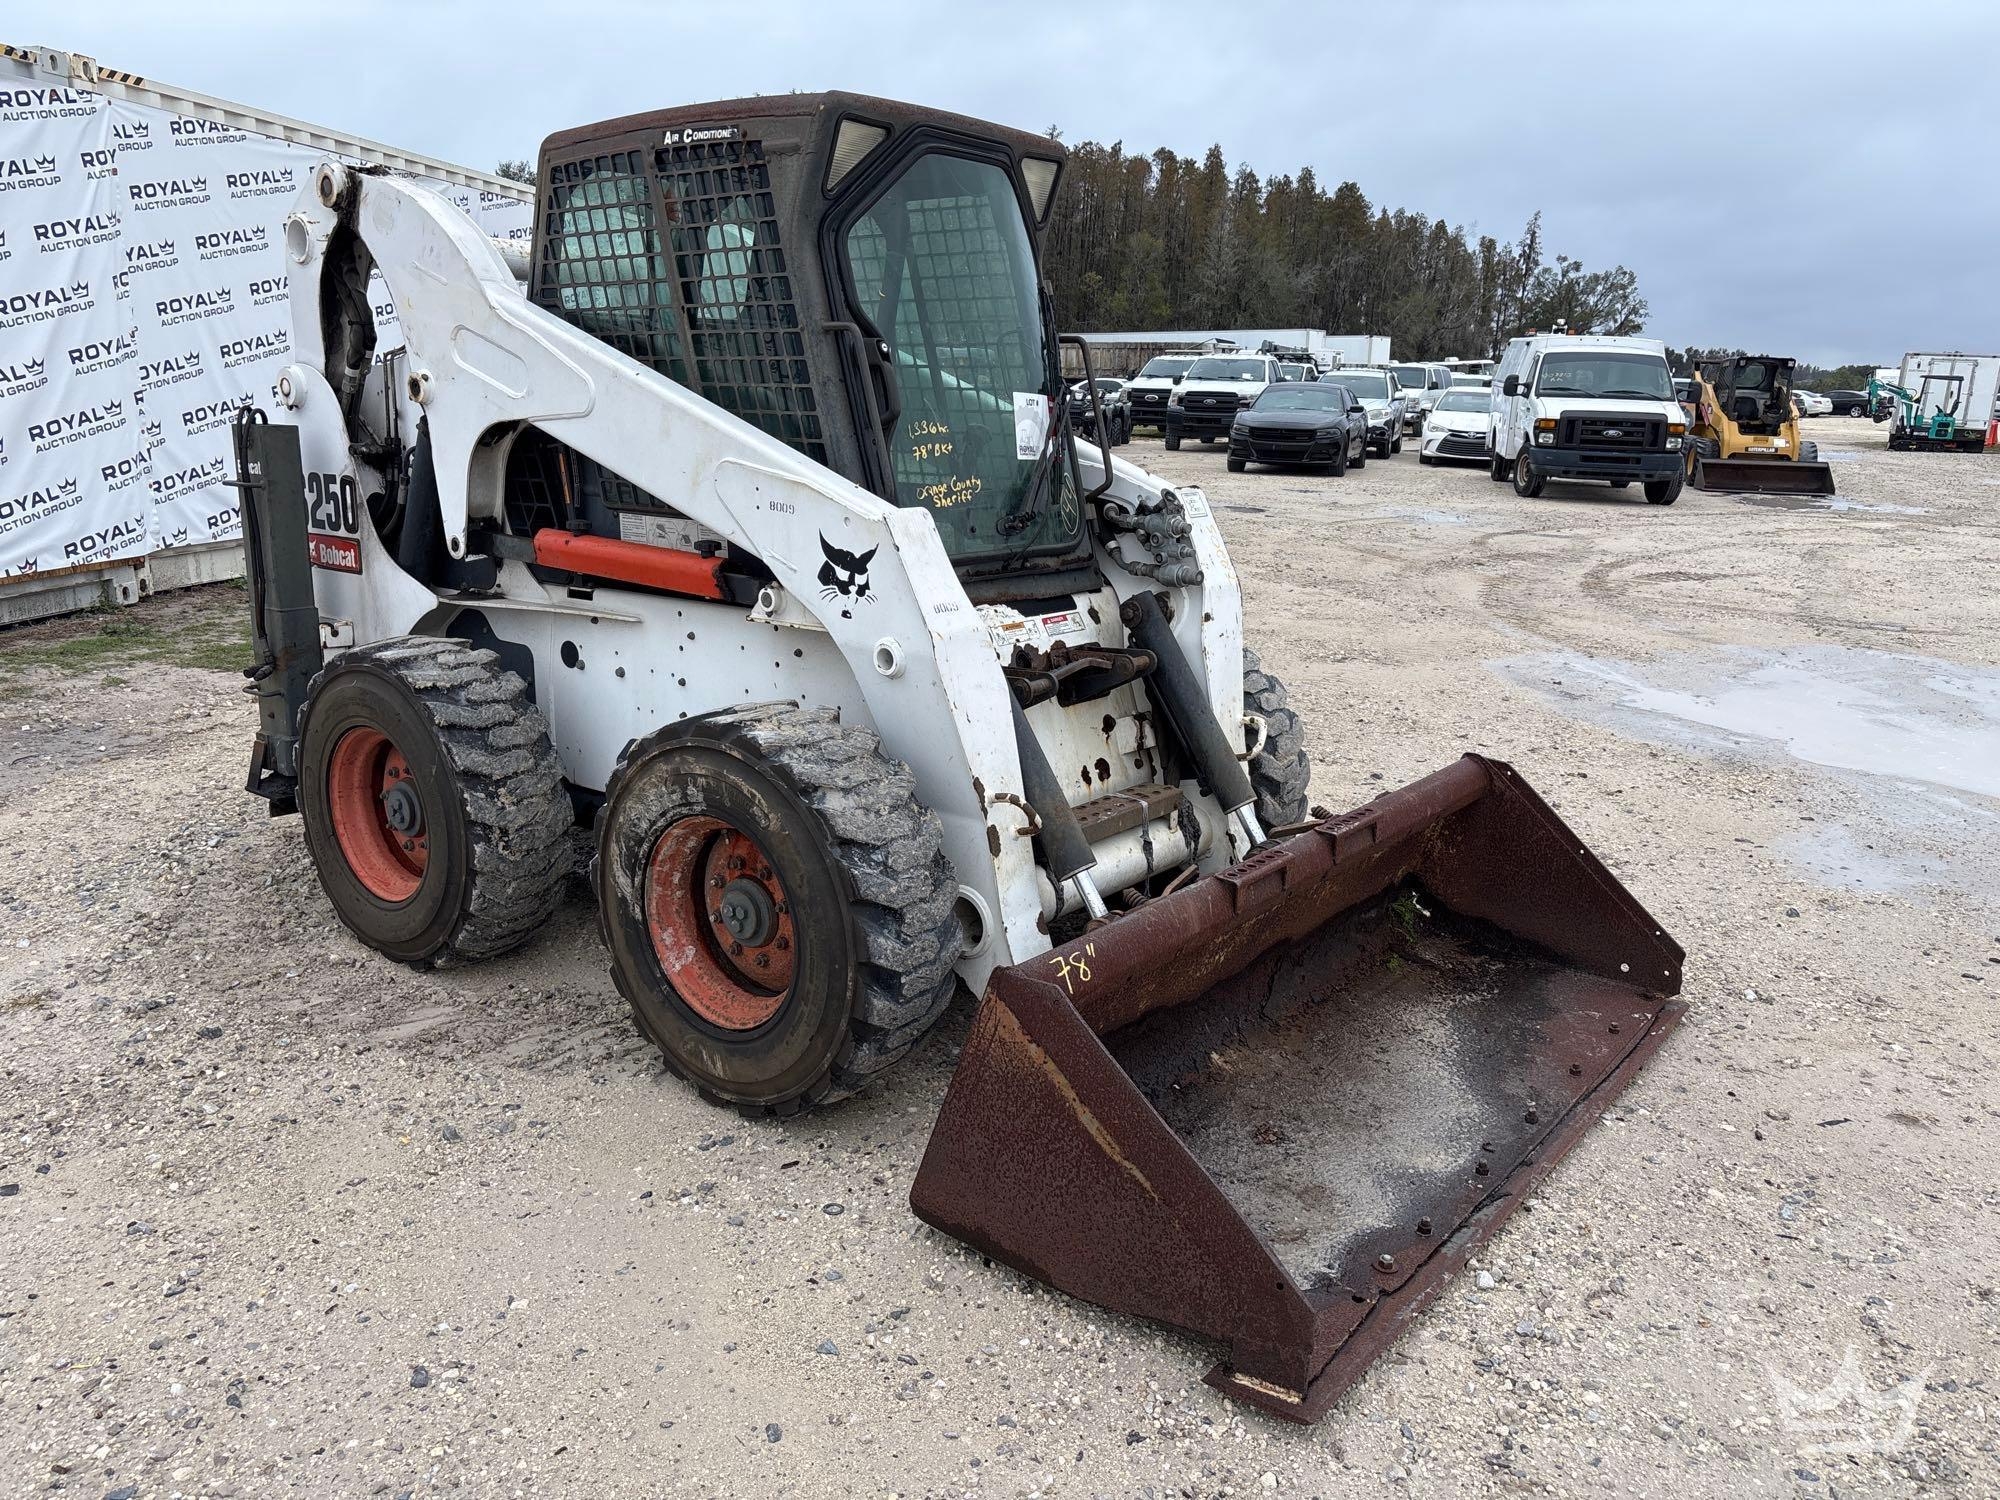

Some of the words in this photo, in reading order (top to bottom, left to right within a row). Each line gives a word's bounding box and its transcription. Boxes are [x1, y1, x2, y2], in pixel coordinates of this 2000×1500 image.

[0, 88, 77, 107] ROYAL
[3, 109, 58, 121] AUCTION
[60, 106, 97, 117] GROUP
[118, 141, 153, 151] GROUP
[175, 137, 215, 147] AUCTION
[216, 134, 247, 144] GROUP
[683, 128, 738, 143] CONDITIONE
[81, 149, 116, 168] ROY
[18, 176, 62, 189] GROUP
[87, 169, 111, 180] AUCT
[226, 170, 280, 188] ROYAL
[129, 180, 193, 200] ROYAL
[231, 188, 268, 199] AUCTION
[268, 184, 296, 195] GROUP
[134, 198, 178, 211] AUCTION
[178, 194, 211, 206] GROUP
[33, 215, 108, 241] ROYAL
[509, 226, 533, 240] ROYA
[40, 237, 91, 253] AUCTION
[195, 229, 252, 250] ROYAL
[126, 244, 160, 261] YAL
[200, 248, 239, 260] AUCTION
[239, 242, 269, 254] GROUP
[145, 258, 179, 271] GROUP
[156, 292, 218, 316] ROYAL
[0, 310, 55, 330] AUCTION
[57, 300, 95, 317] GROUP
[161, 312, 202, 327] AUCTION
[203, 304, 235, 318] GROUP
[68, 335, 131, 365] ROYAL
[220, 334, 274, 358] ROYAL
[224, 353, 261, 369] AUCTION
[262, 345, 290, 358] GROUP
[139, 357, 185, 380] OYAL
[171, 368, 204, 383] GROUP
[6, 377, 48, 396] GROUP
[182, 399, 240, 426] ROYAL
[28, 408, 105, 442] ROYAL
[187, 416, 226, 437] AUCTION
[35, 430, 87, 454] AUCTION
[88, 418, 127, 437] GROUP
[155, 484, 195, 506] AUCTION
[196, 472, 228, 490] GROUP
[0, 488, 60, 519] OYAL
[306, 472, 359, 534] 250
[0, 511, 41, 535] CTION
[43, 495, 83, 517] GROUP
[207, 507, 241, 530] ROY
[64, 521, 137, 559] ROYAL
[319, 543, 356, 568] Bobcat
